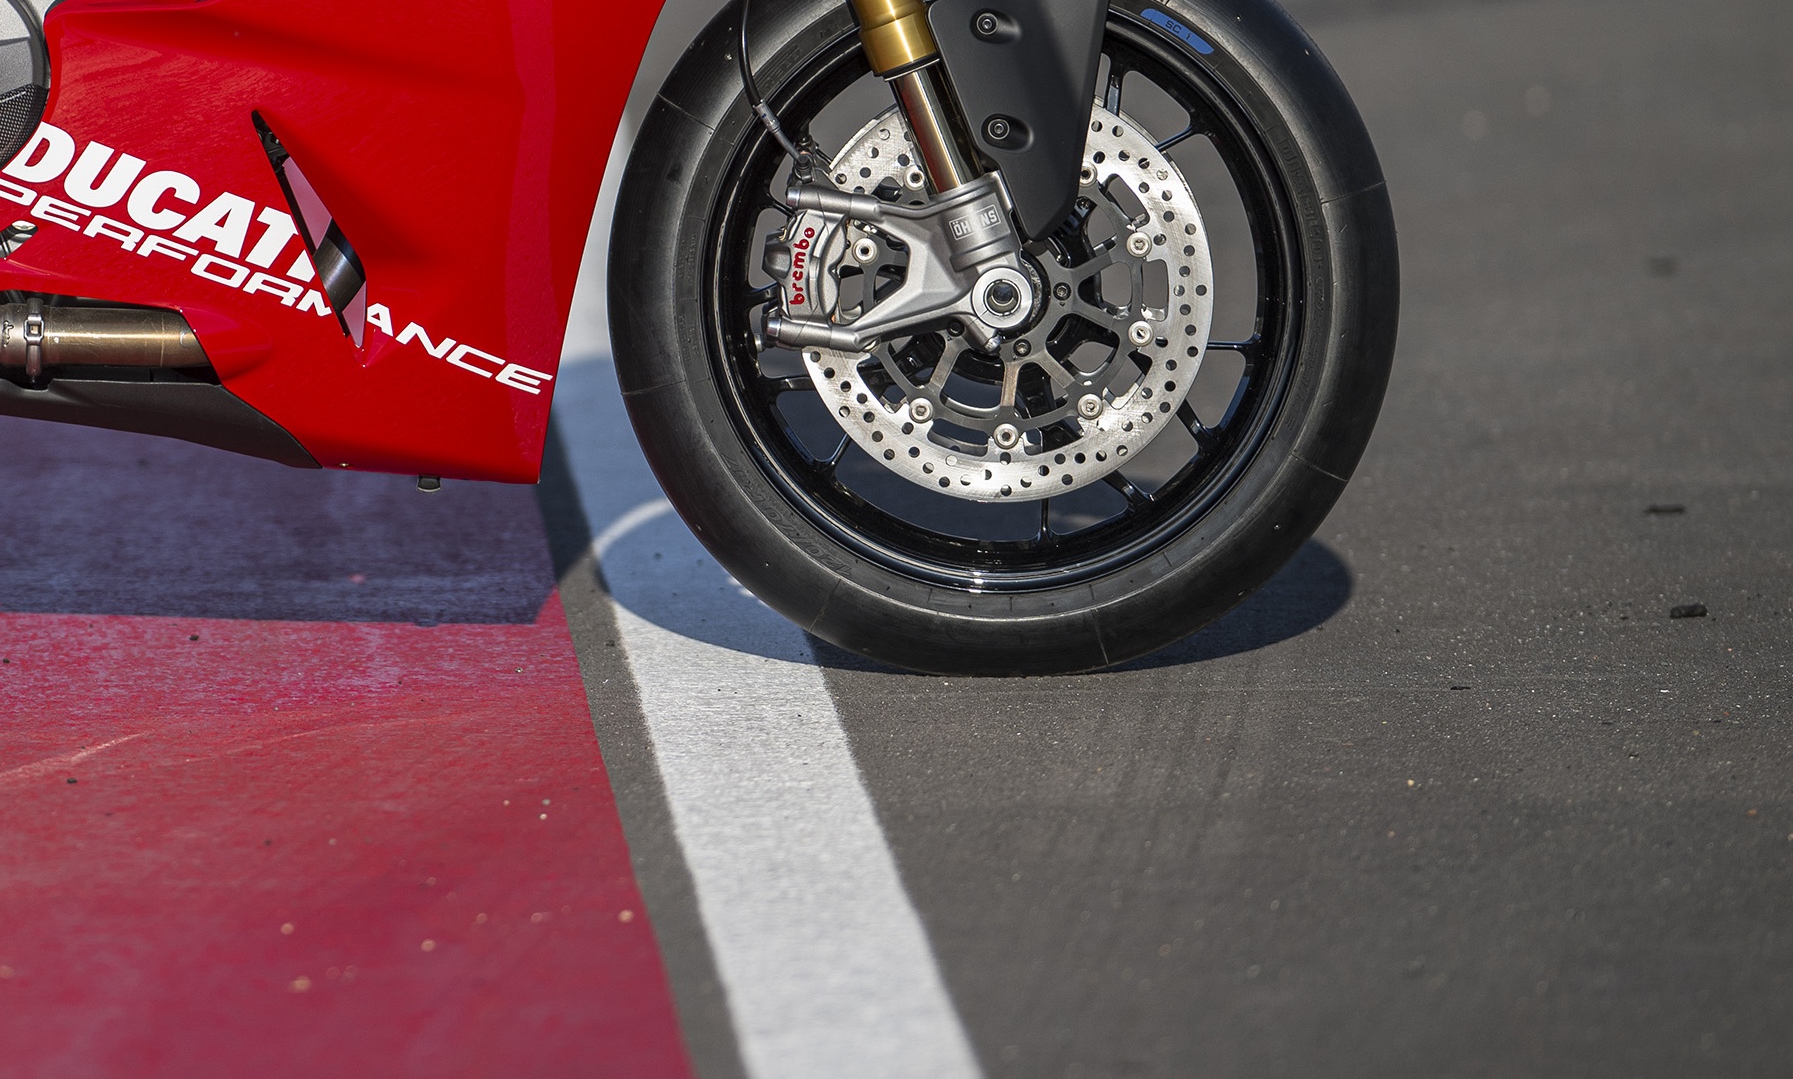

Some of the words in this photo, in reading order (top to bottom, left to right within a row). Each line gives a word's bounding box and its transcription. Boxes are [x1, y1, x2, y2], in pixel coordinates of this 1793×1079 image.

[1165, 20, 1182, 34] SC
[951, 209, 998, 237] ÖHNS
[789, 227, 815, 305] brembo
